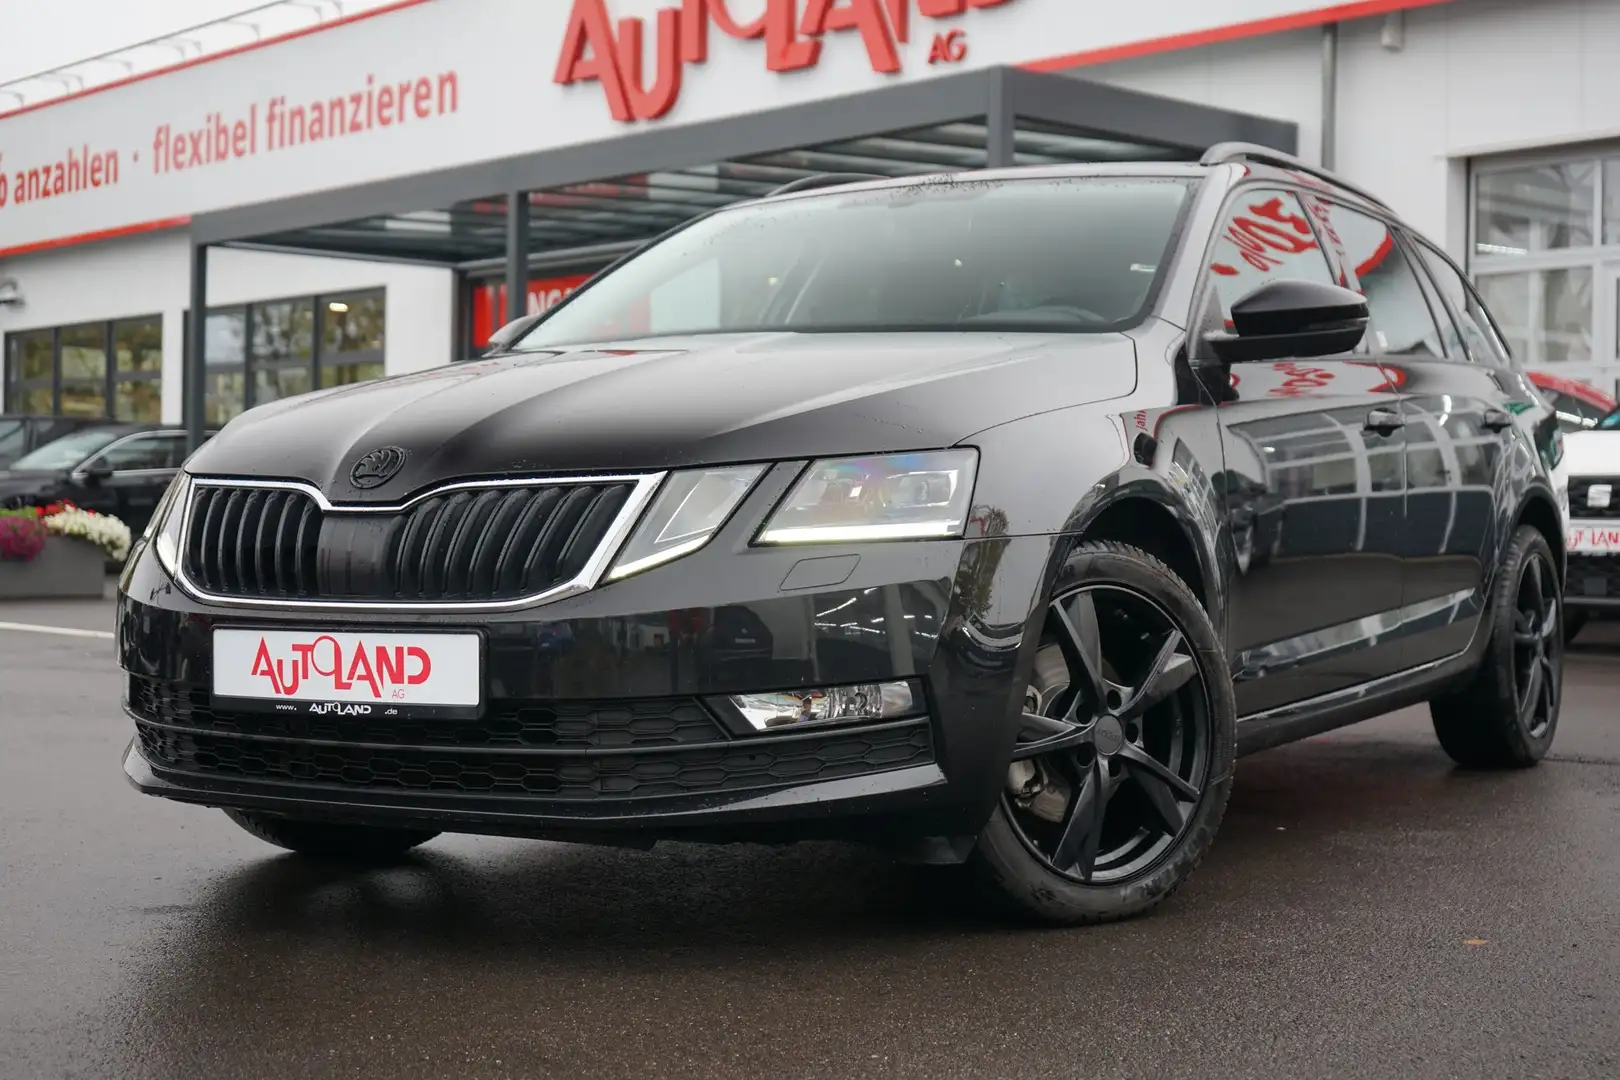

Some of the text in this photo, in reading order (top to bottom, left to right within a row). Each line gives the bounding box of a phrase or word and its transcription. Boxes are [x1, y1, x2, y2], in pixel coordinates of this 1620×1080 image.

[552, 0, 1020, 122] AUTLA
[927, 29, 968, 64] AG
[14, 143, 119, 205] anzahlen
[153, 103, 257, 174] flexibel
[265, 73, 458, 151] finanzieren
[251, 635, 432, 698] AUTOLAND
[275, 701, 398, 716] www. AUTOLAND .de
[391, 688, 405, 700] AG
